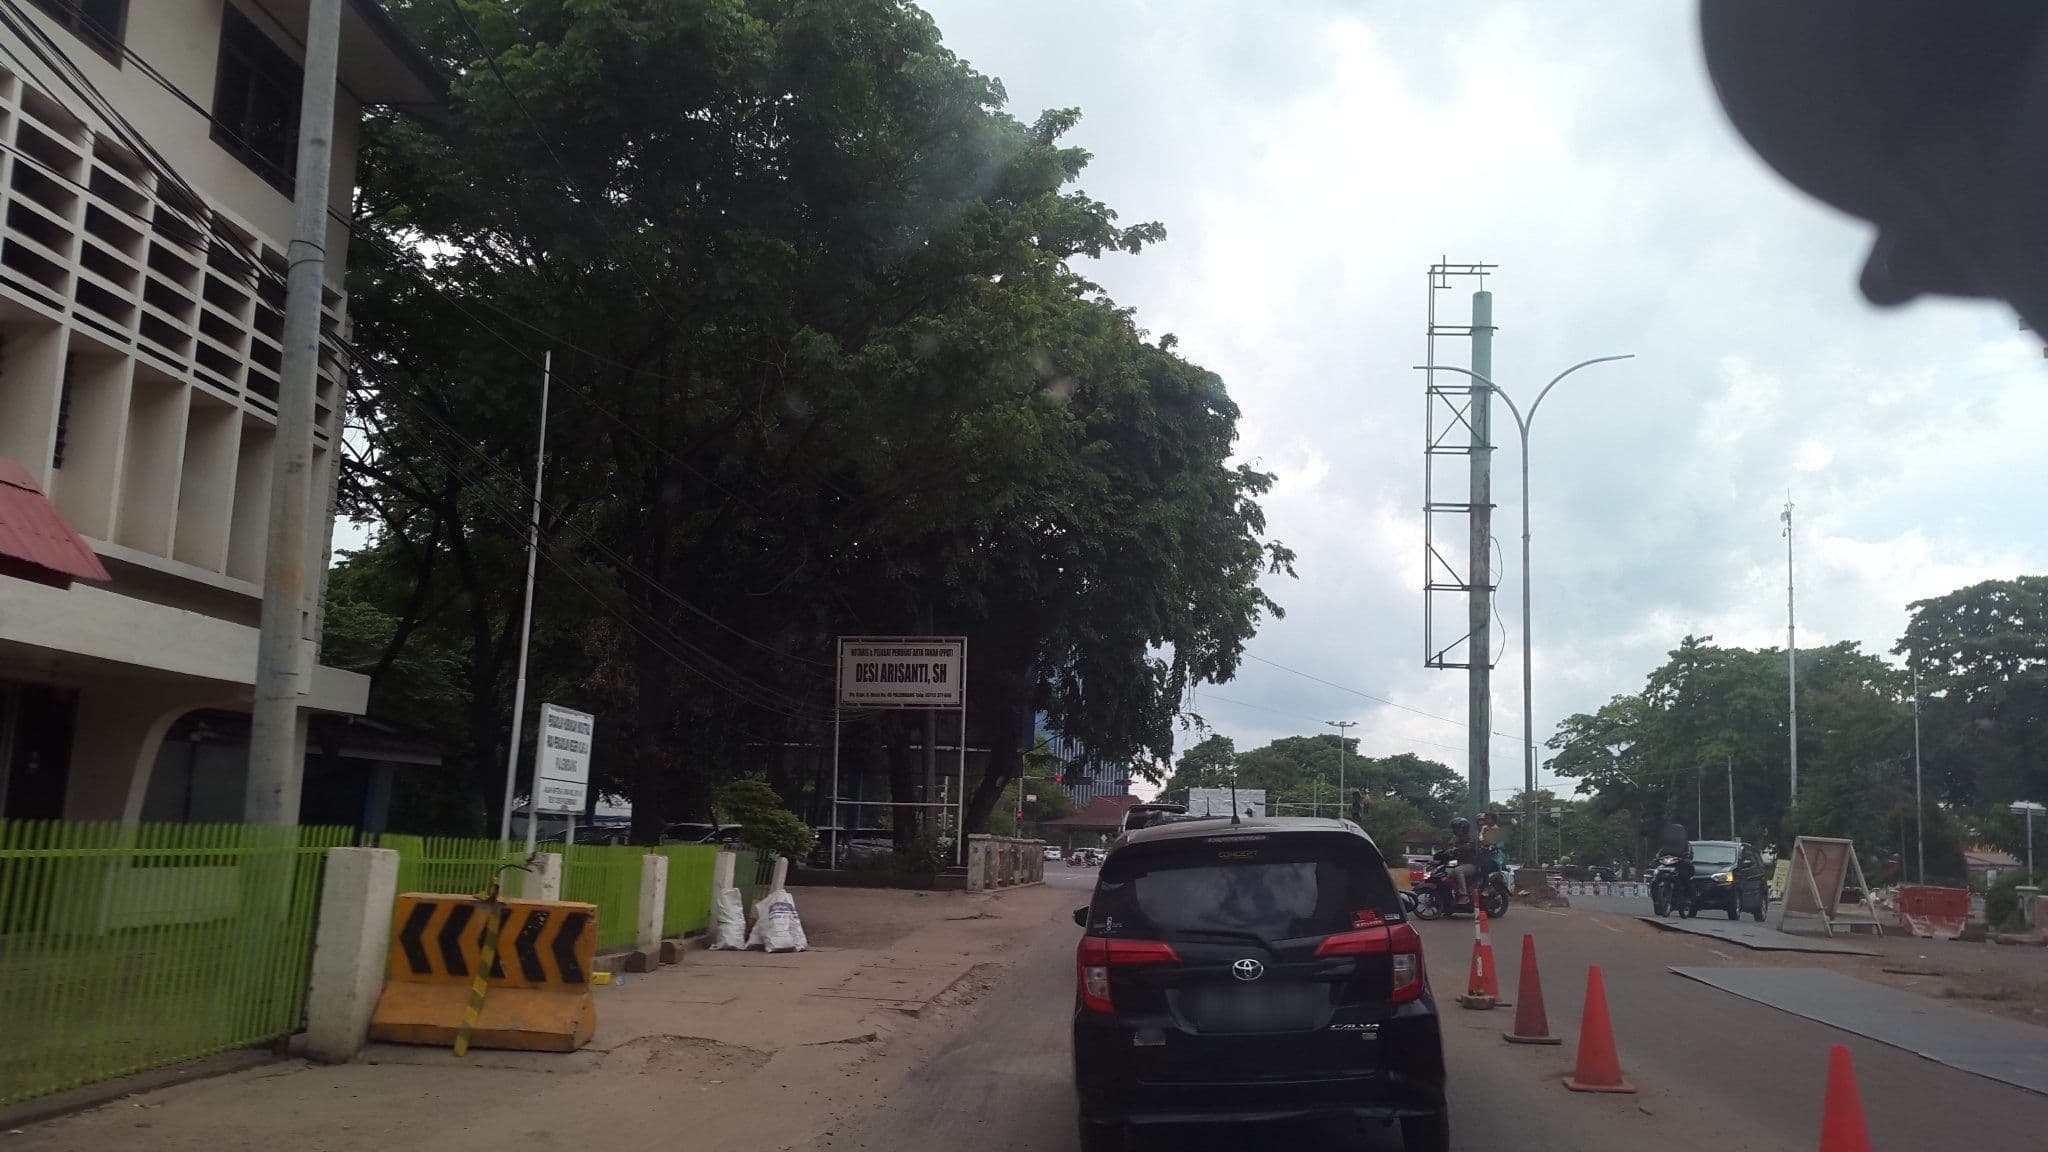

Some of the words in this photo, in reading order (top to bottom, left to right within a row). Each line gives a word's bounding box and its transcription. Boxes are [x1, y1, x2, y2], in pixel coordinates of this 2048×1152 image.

[855, 662, 878, 683] DESI
[880, 662, 931, 684] ARISANTI,
[932, 662, 947, 683] SH
